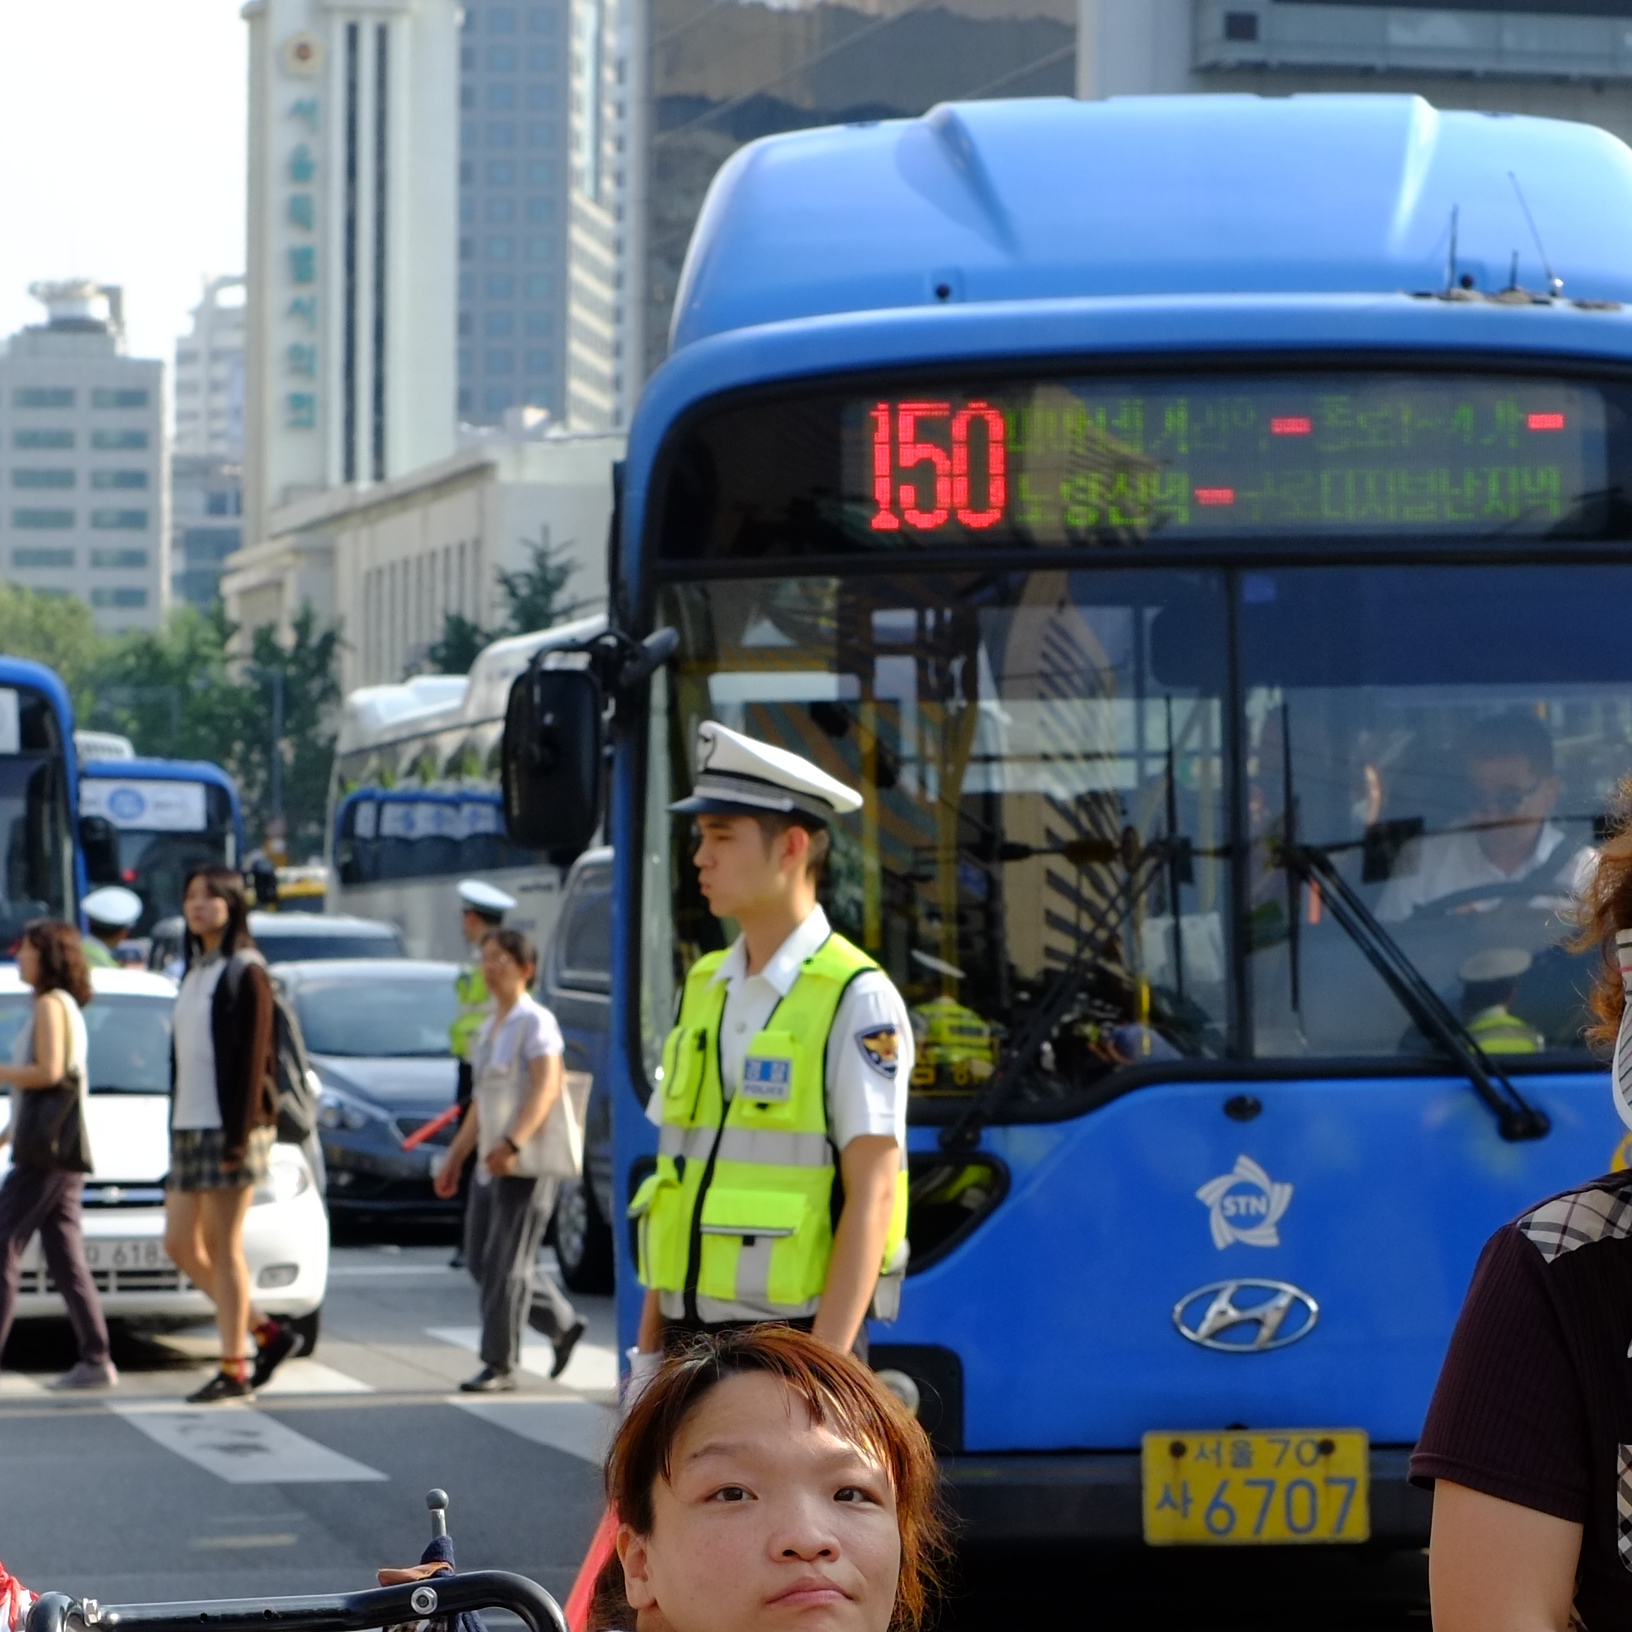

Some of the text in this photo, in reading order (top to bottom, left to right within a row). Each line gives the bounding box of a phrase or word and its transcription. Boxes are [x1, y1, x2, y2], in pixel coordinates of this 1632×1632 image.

[869, 401, 1006, 530] 150
[1223, 1194, 1268, 1217] STN
[1194, 1437, 1320, 1470] 서울 70
[1155, 1476, 1358, 1537] 사 6707
